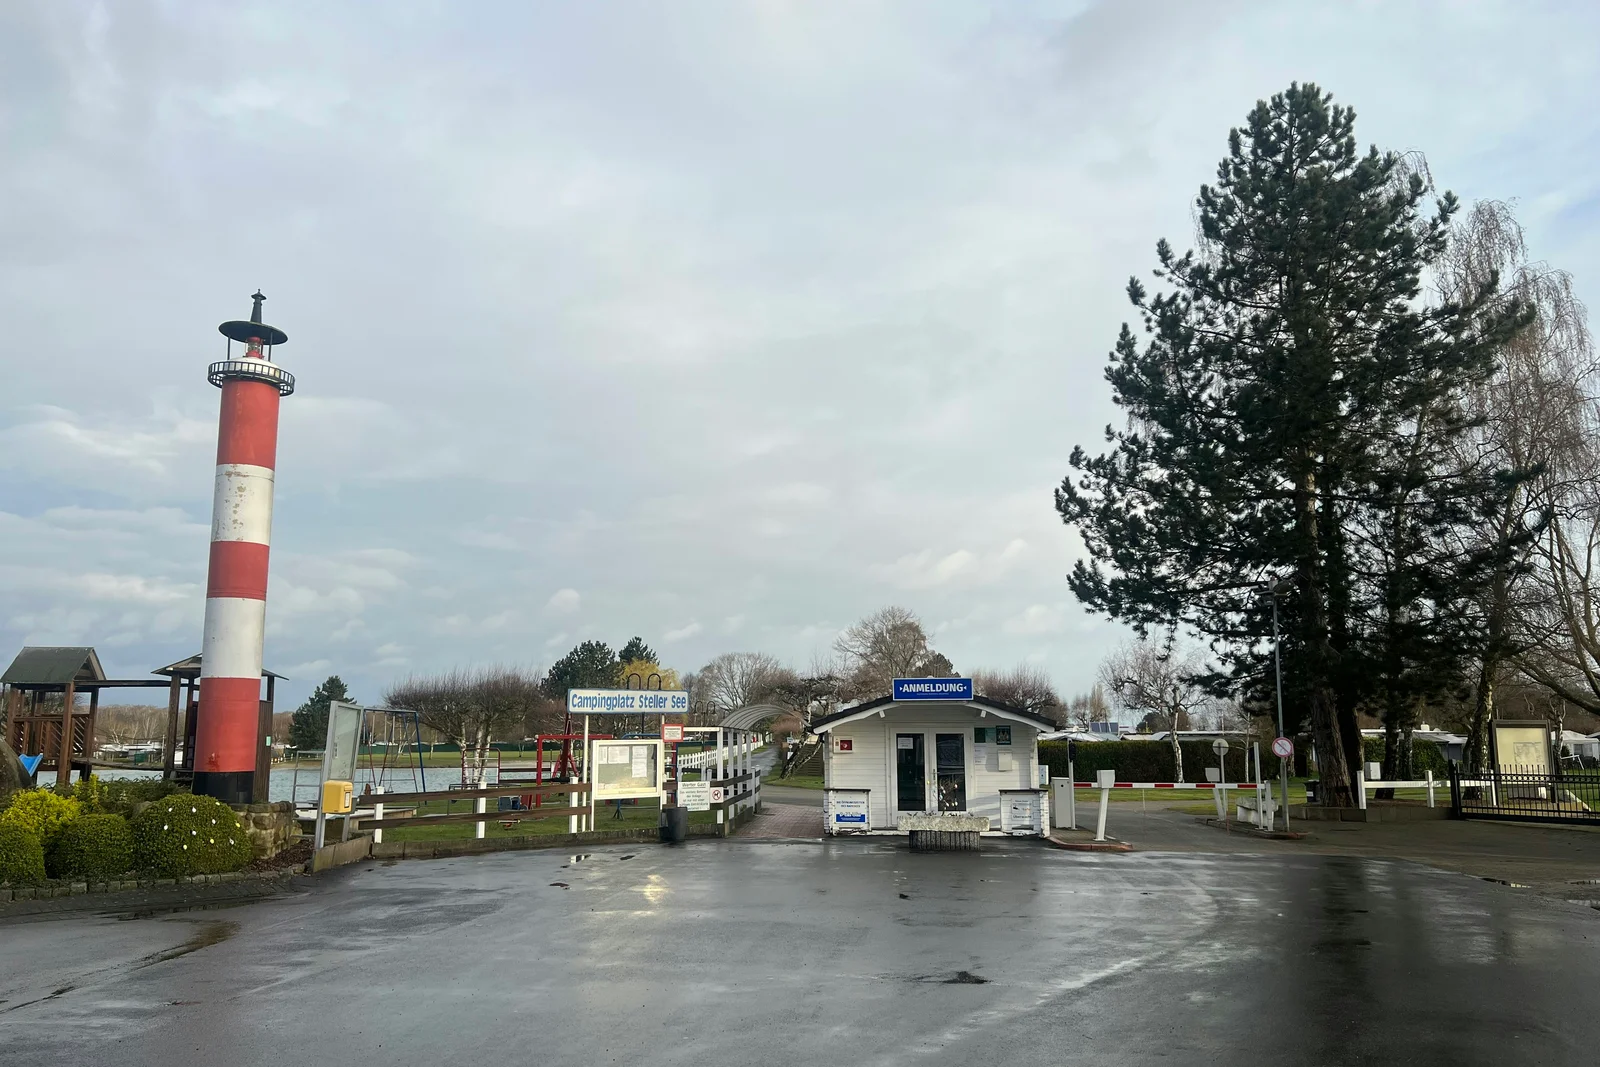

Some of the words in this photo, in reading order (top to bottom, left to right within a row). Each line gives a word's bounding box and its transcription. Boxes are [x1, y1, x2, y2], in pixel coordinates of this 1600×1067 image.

[902, 683, 964, 693] ANMELDUNG
[571, 693, 635, 710] Campingplatz
[639, 694, 668, 709] Steller
[671, 695, 687, 709] See
